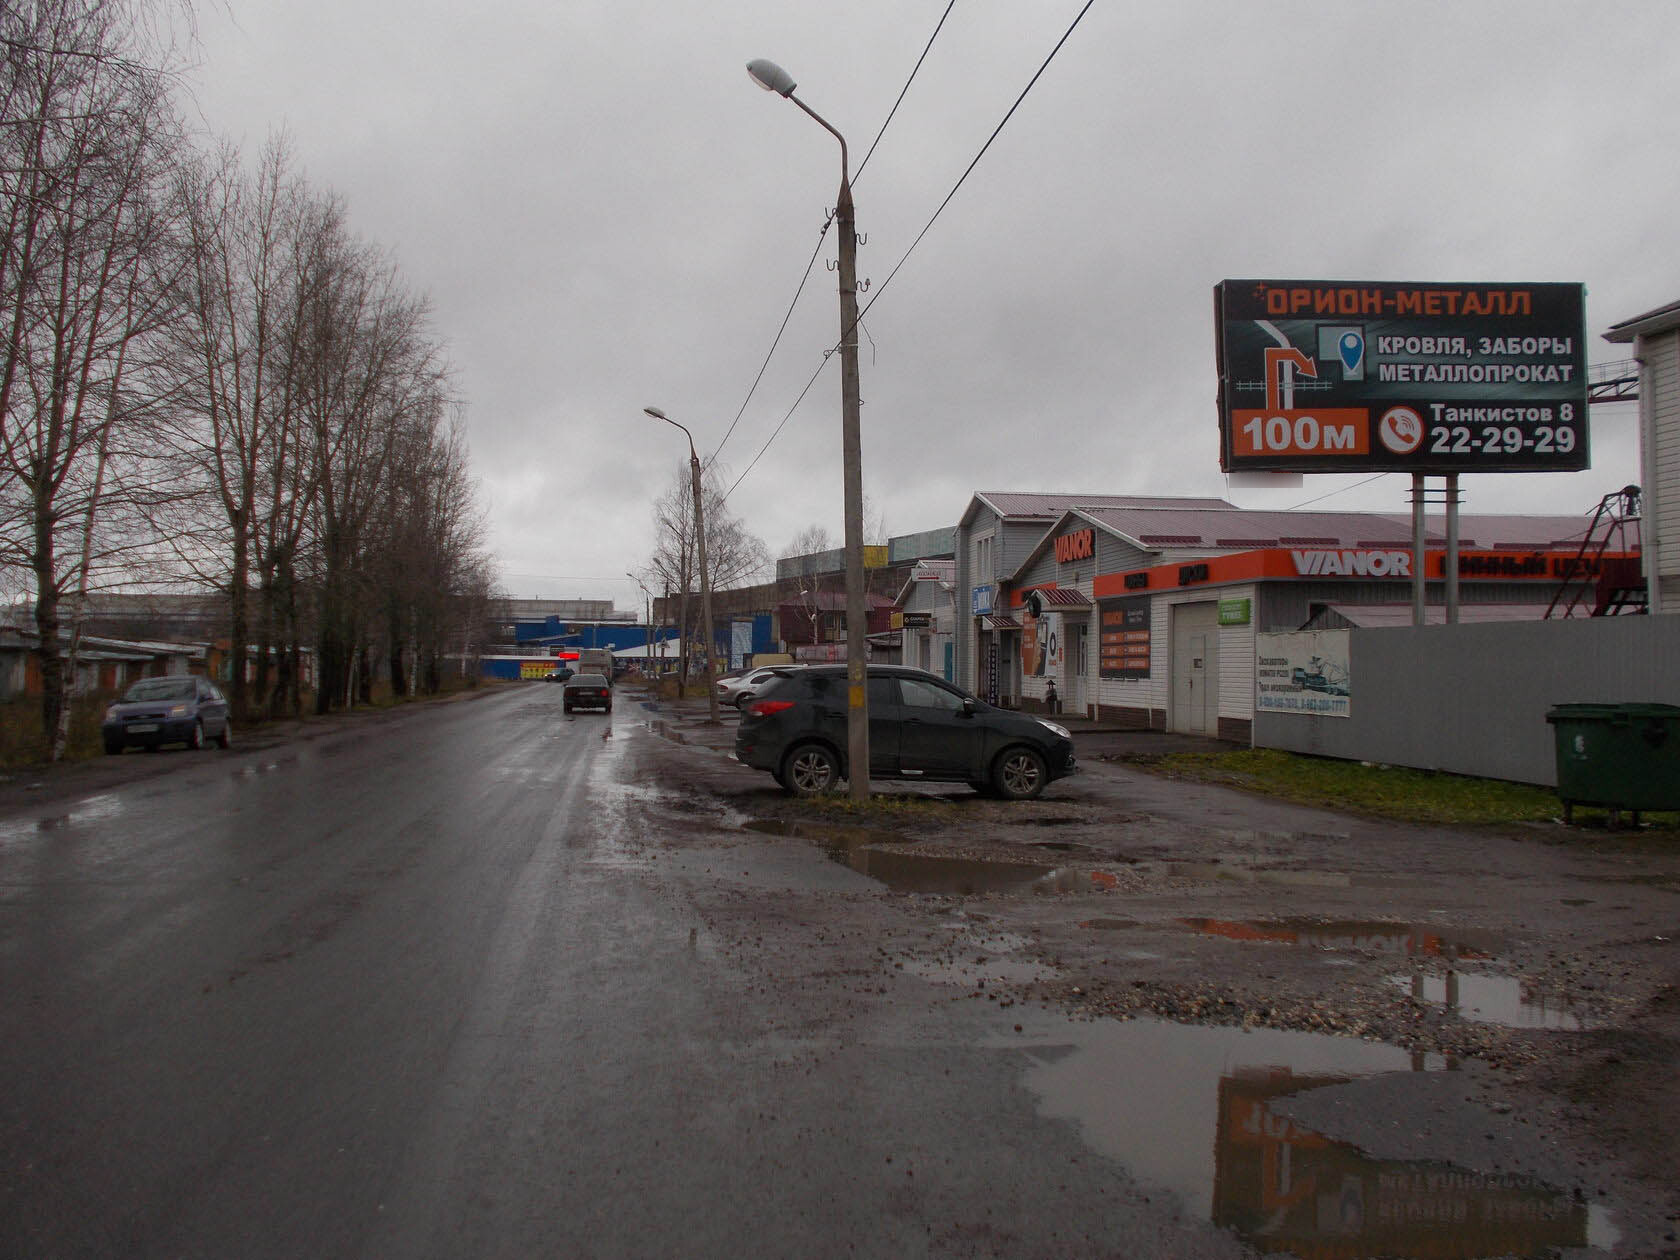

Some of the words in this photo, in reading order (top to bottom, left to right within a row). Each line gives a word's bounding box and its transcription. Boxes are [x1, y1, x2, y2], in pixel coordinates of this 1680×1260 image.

[1267, 289, 1531, 315] ОРИОН-МЕТАЛЛ
[1378, 336, 1472, 358] КРОВЛЯ,
[1479, 337, 1571, 354] ЗАБОРЫ
[1379, 364, 1572, 382] МЕТАЛЛОПРОКАТ
[1430, 403, 1552, 421] Танкистов
[1560, 403, 1573, 421] 8
[1431, 426, 1575, 453] 22-29-29
[1291, 550, 1410, 576] VIANOR
